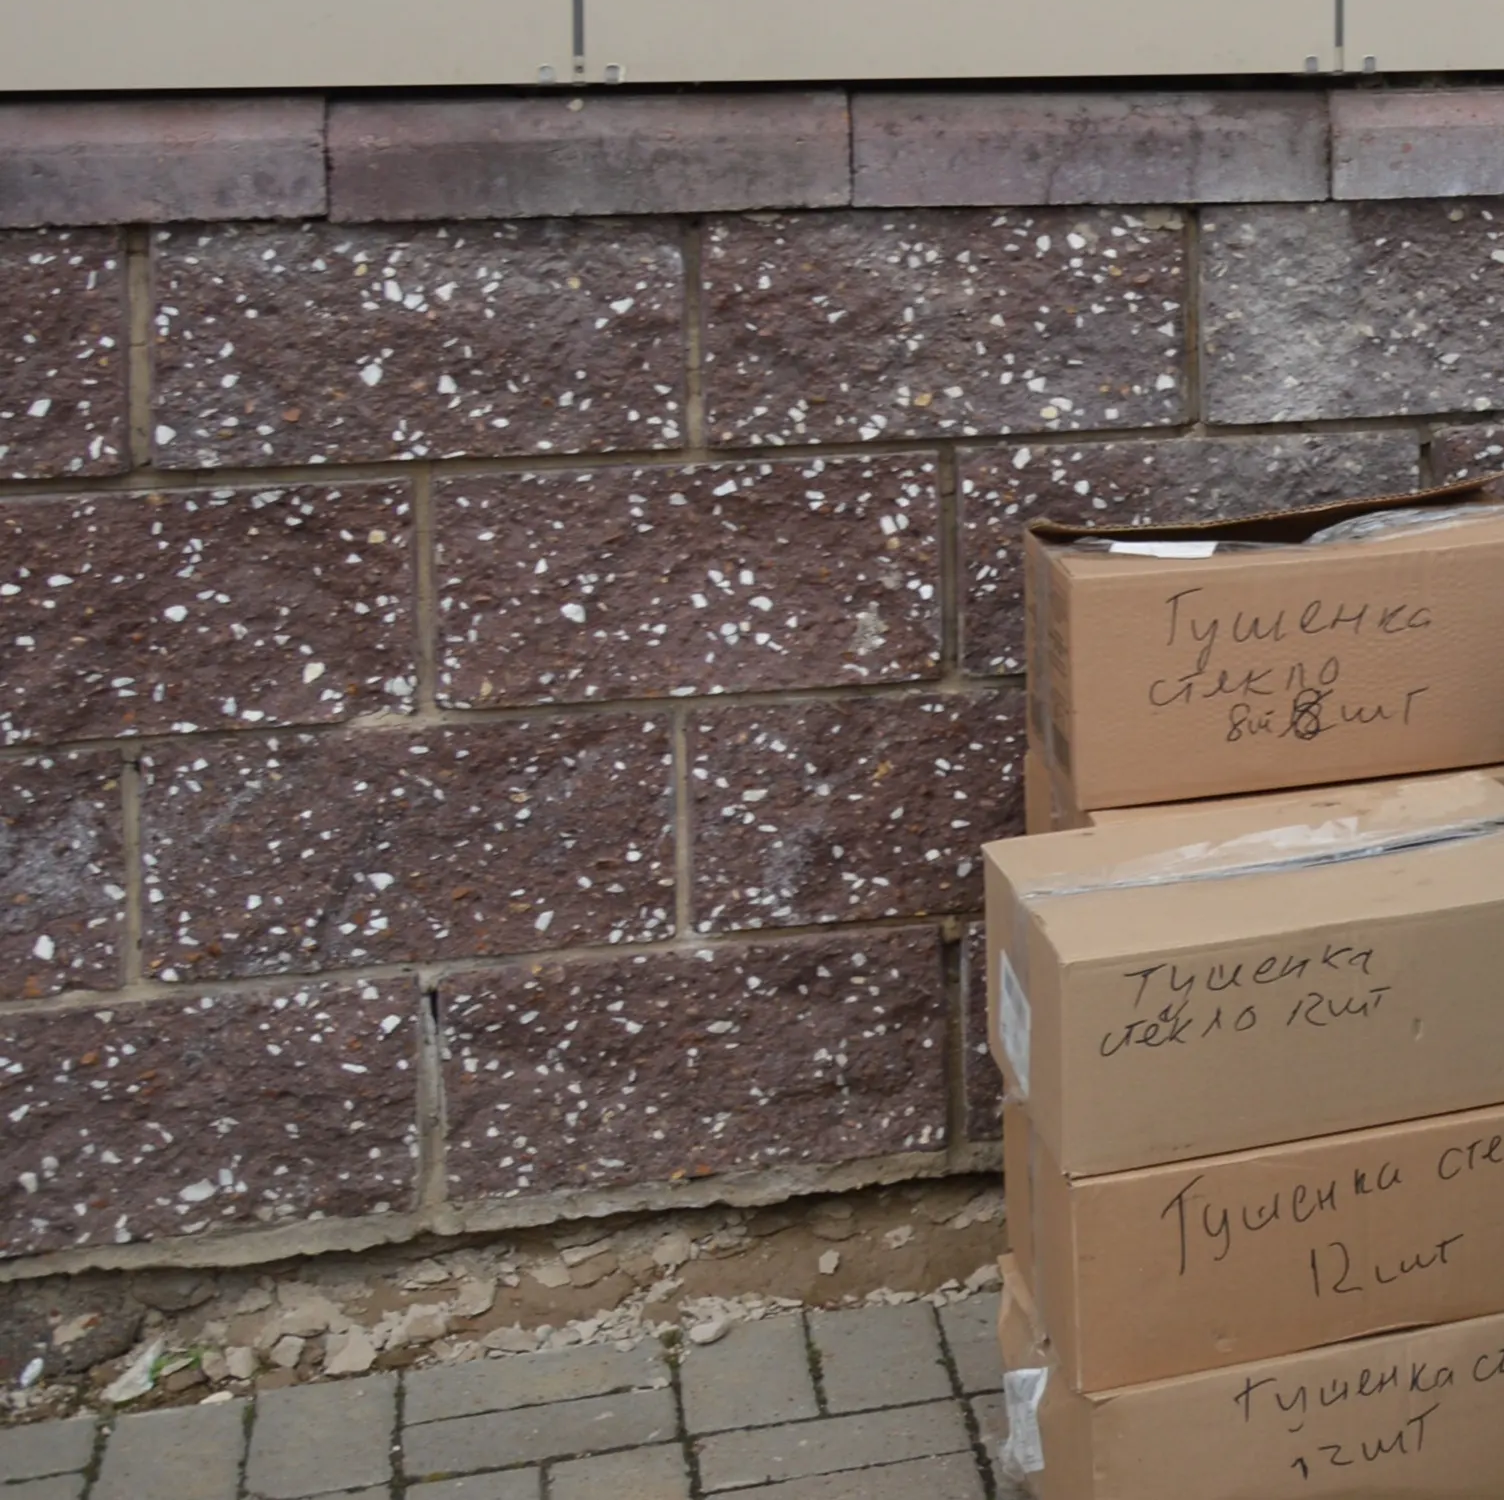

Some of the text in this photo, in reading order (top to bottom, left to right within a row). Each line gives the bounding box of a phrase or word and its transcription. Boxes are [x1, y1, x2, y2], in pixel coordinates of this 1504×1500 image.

[1165, 587, 1432, 673] Тушенка
[1124, 945, 1373, 1022] Тушенка
[1161, 1161, 1402, 1277] Тушенка
